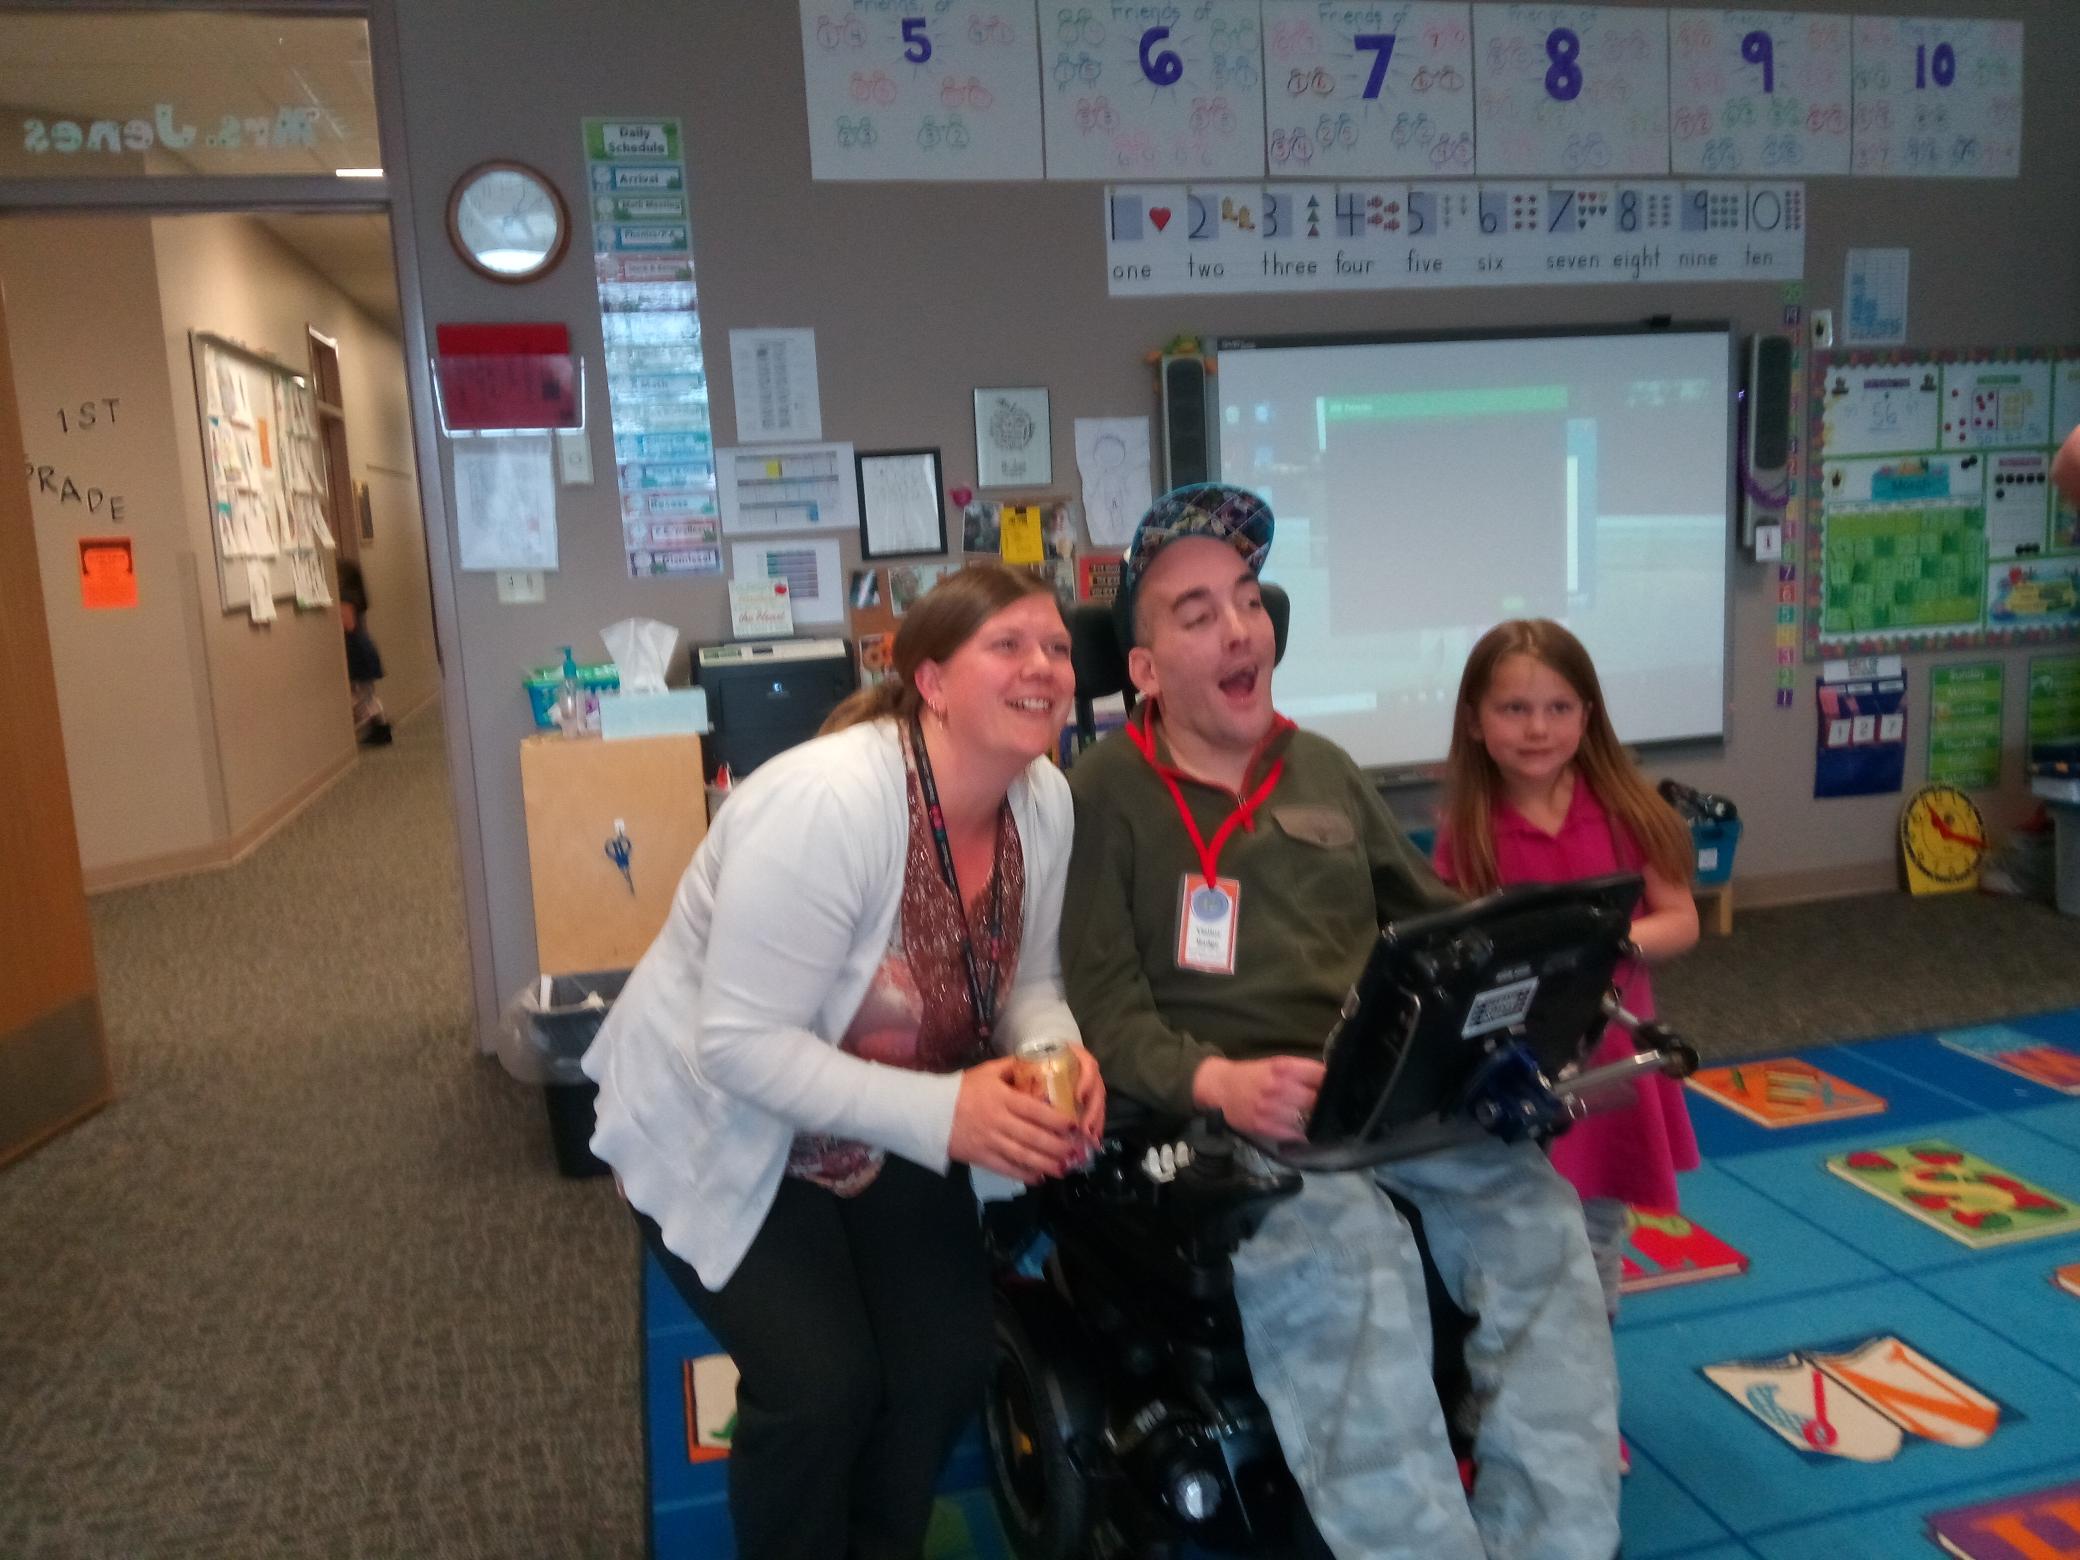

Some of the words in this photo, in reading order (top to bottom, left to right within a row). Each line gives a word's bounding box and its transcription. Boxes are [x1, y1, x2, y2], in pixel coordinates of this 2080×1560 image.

[901, 16, 932, 64] 5
[1138, 26, 1184, 86] 6
[1741, 30, 1773, 93] 9
[1353, 34, 1396, 99] 7
[1545, 27, 1583, 101] 8
[1915, 42, 1955, 89] 10
[608, 142, 665, 153] Schedule
[619, 126, 650, 141] Daily
[1110, 195, 1116, 241] 1
[1187, 194, 1210, 239] 2
[1262, 193, 1278, 238] 3
[1335, 193, 1365, 237] 4
[1407, 192, 1425, 235] 5
[1478, 190, 1498, 233] 6
[1547, 190, 1576, 233] 7
[1620, 190, 1638, 232] 8
[1694, 190, 1709, 231] 9
[1745, 190, 1782, 232] 10
[1112, 264, 1152, 280] one
[1187, 252, 1225, 279] two
[1262, 251, 1317, 276] three
[1335, 251, 1376, 274] four
[1407, 248, 1443, 274] five
[1478, 251, 1504, 272] six
[1546, 252, 1601, 270] seven
[1612, 244, 1661, 280] eight
[1679, 249, 1719, 266] nine
[1745, 245, 1774, 266] ten
[57, 398, 120, 434] 1ST
[1860, 721, 1869, 736] 2
[1812, 1342, 2000, 1443] N
